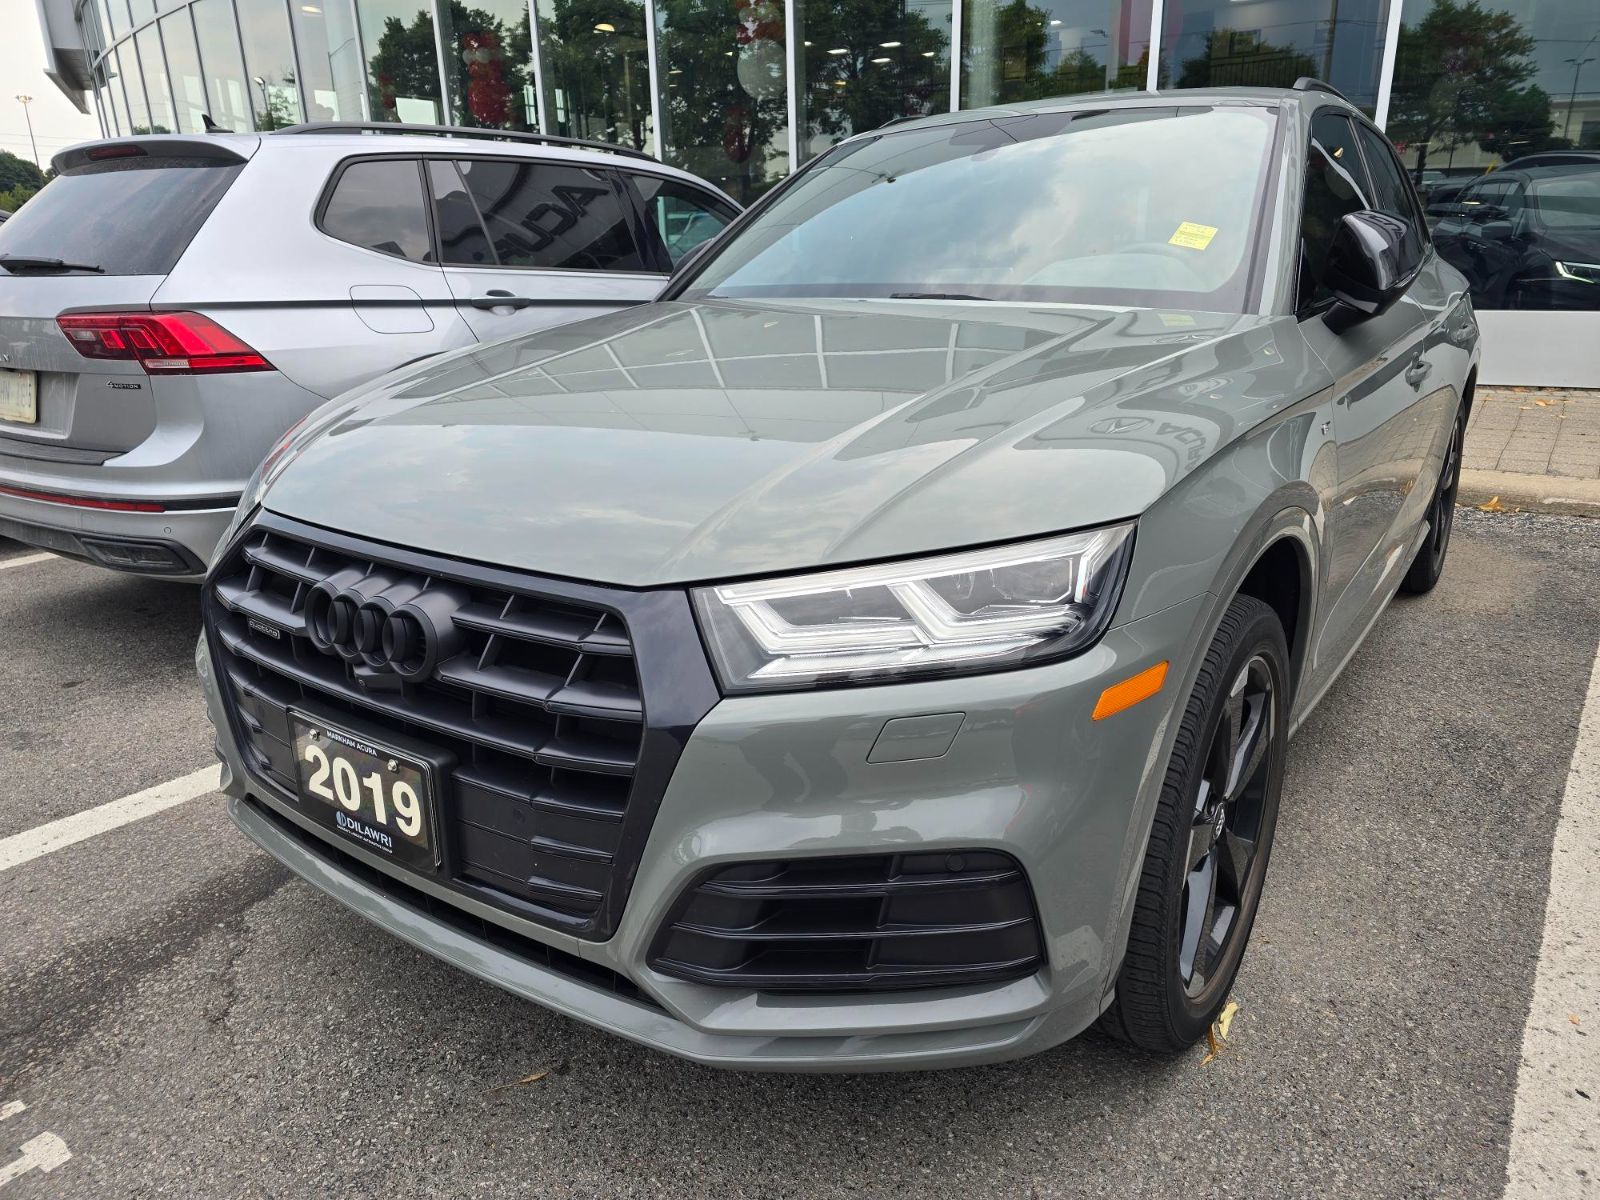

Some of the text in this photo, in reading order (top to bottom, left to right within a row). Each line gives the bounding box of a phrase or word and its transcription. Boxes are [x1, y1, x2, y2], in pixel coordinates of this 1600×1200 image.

[249, 620, 278, 637] quattro
[326, 730, 378, 757] MARKHAM ACURA
[305, 745, 421, 837] 2019
[346, 817, 392, 848] DILAWRI
